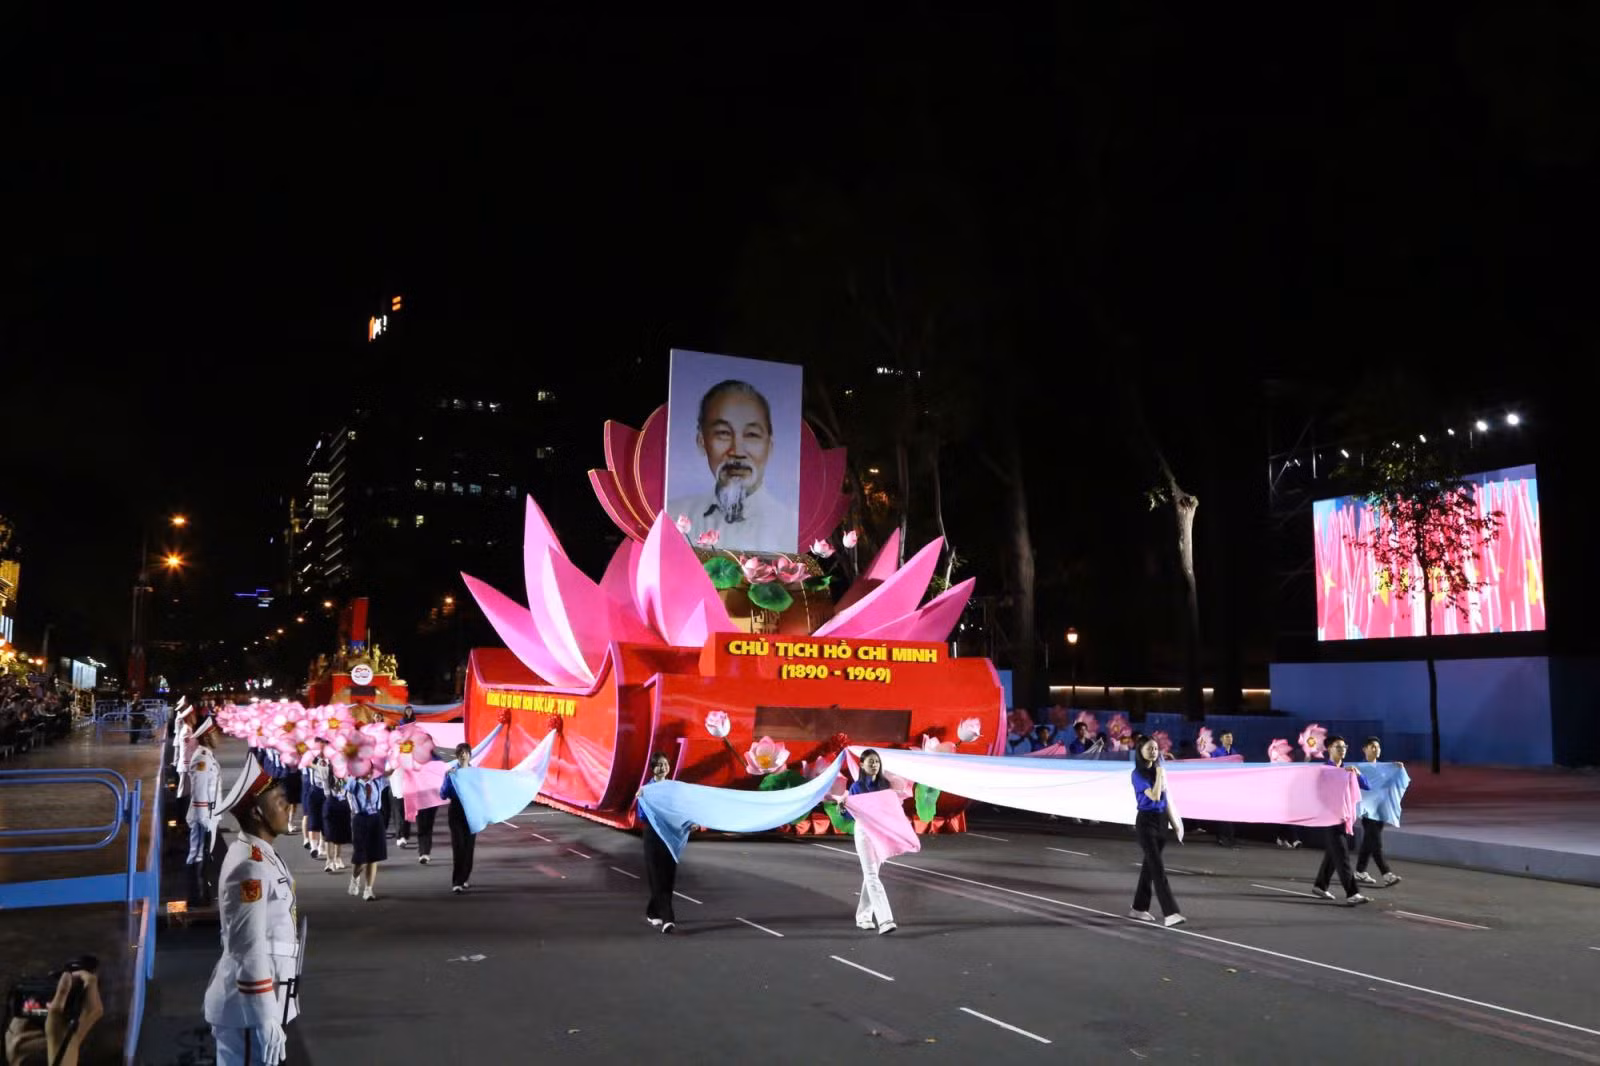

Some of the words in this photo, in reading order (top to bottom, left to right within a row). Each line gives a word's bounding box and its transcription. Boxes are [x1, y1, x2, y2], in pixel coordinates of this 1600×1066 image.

[729, 638, 769, 656] CHỦ
[775, 642, 818, 660] TỊCH
[824, 640, 852, 658] HỒ
[858, 643, 887, 660] CHÍ
[892, 648, 937, 662] MINH
[782, 664, 828, 680] (1890
[847, 667, 891, 684] 1969)
